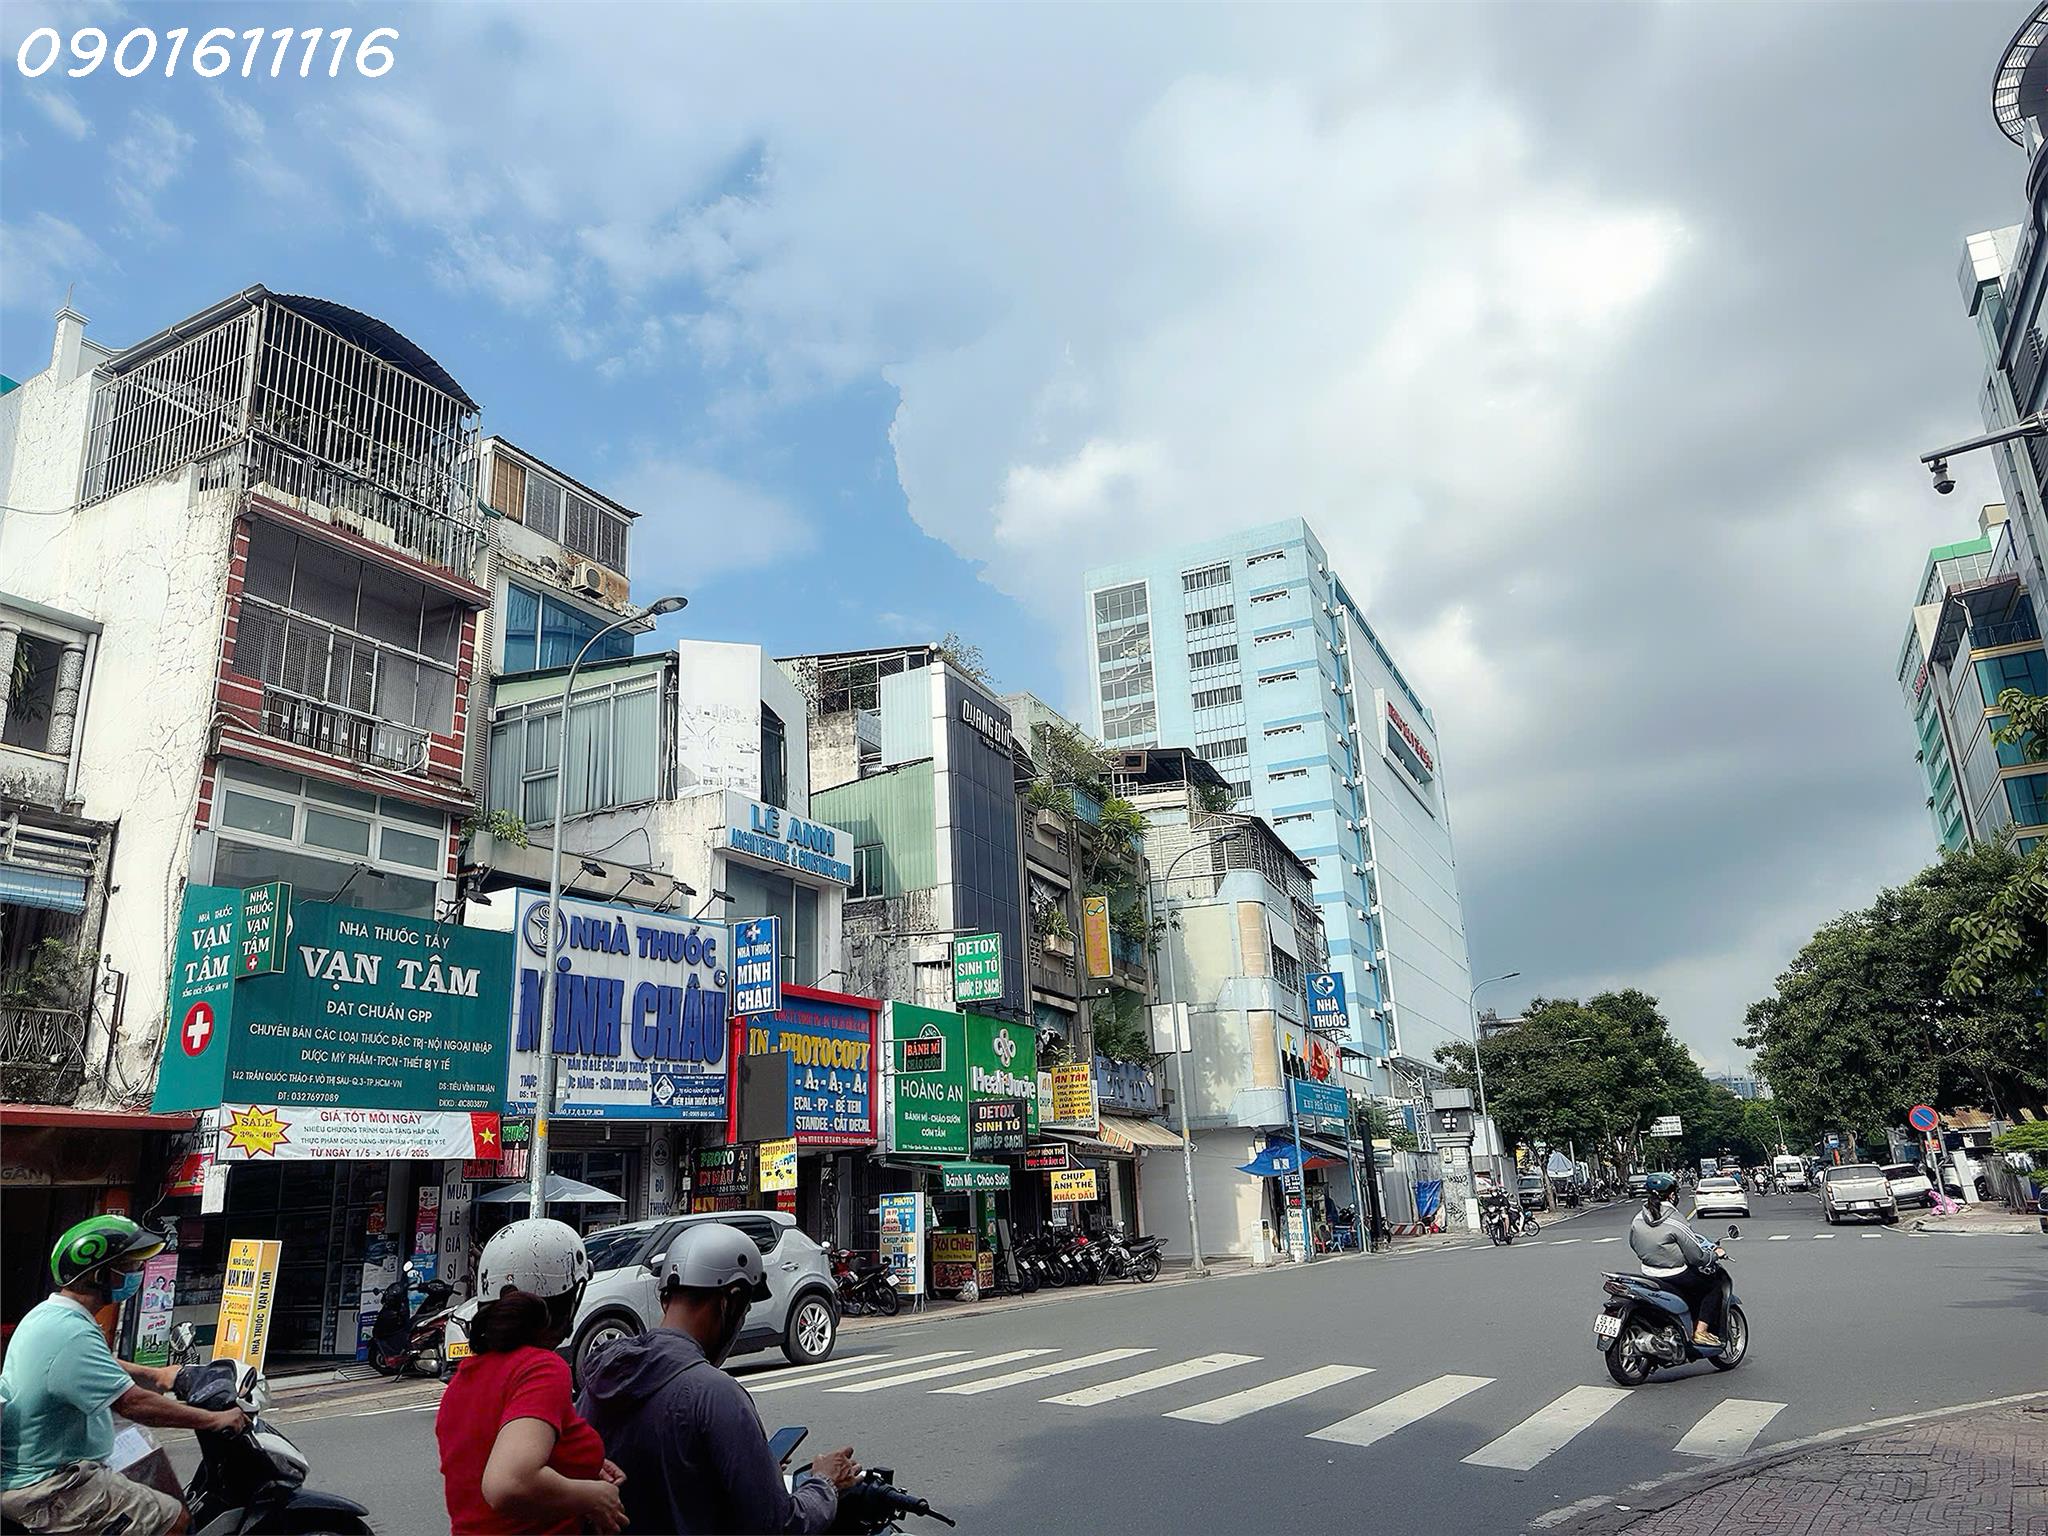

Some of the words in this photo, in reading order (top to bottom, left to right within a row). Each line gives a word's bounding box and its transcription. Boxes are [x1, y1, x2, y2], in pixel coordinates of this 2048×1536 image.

[751, 804, 780, 839] LÊ
[787, 817, 835, 857] ANH
[730, 828, 790, 865] ARCHITECTURE
[791, 847, 798, 867] &
[799, 849, 852, 883] CONSTRUCTION
[250, 887, 269, 903] NHÀ
[245, 901, 274, 917] THUỐC
[246, 916, 270, 935] VẠN
[191, 923, 233, 953] VẠN
[242, 936, 270, 956] TÂM
[374, 926, 419, 945] THUỐC
[424, 933, 450, 949] TÂY
[569, 915, 630, 956] NHÀ
[636, 926, 717, 969] THUỐC
[737, 944, 750, 959] NHÀ
[751, 941, 772, 955] THUỐC
[957, 938, 997, 957] DETOX
[184, 955, 231, 984] TÂM
[299, 946, 382, 991] VẠN
[396, 954, 481, 997] TÂM
[958, 961, 983, 976] SINH
[985, 955, 998, 974] TỐ
[737, 984, 772, 1011] CHÂU
[1316, 996, 1339, 1012] NHÀ
[327, 1000, 355, 1017] ĐẠT
[358, 1002, 404, 1021] CHUẨN
[408, 1010, 433, 1024] GPP
[631, 973, 727, 1065] CHÂU
[1312, 1011, 1348, 1028] THUỐC
[249, 1023, 290, 1037] CHUYÊN
[292, 1025, 312, 1038] BÁN
[314, 1027, 337, 1041] CÁC
[339, 1031, 359, 1045] LOẠI
[361, 1031, 390, 1045] THUỐC
[443, 1040, 471, 1053] NGOẠI
[472, 1041, 493, 1055] NHẬP
[749, 1028, 770, 1056] IN
[780, 1031, 871, 1071] PHOTOCOPY
[907, 1041, 929, 1057] BÁNH
[433, 1060, 440, 1070] Y
[441, 1058, 450, 1070] TẾ
[232, 1070, 245, 1080] 142
[803, 1069, 819, 1091] A2
[828, 1071, 843, 1094] A3
[852, 1073, 867, 1095] A4
[291, 1092, 339, 1103] 0327697089
[900, 1078, 945, 1101] HOÀNG
[947, 1085, 963, 1102] AN
[817, 1098, 829, 1111] PP
[979, 1104, 1016, 1120] DETOX
[241, 1118, 272, 1128] SALE
[320, 1110, 341, 1122] GIÁ
[344, 1110, 366, 1123] TỐT
[393, 1112, 422, 1125] NGÀY
[795, 1115, 829, 1131] STANDEE
[849, 1119, 871, 1132] DECAL
[975, 1122, 1003, 1133] SINH
[1005, 1116, 1021, 1132] TỐ
[310, 1146, 323, 1157] TỪ
[325, 1146, 351, 1157] NGÀY
[356, 1148, 371, 1158] 1/5
[411, 1149, 430, 1158] 2025
[700, 1150, 735, 1168] PHOTO
[1054, 1181, 1073, 1190] ẢNH
[1075, 1178, 1094, 1188] THẺ
[1061, 1173, 1086, 1181] CHỤP
[447, 1184, 468, 1200] MUA
[1053, 1191, 1076, 1201] KHẮC
[1078, 1189, 1095, 1199] DẤU
[894, 1197, 914, 1206] PHOTO
[449, 1206, 461, 1226] LẺ
[445, 1237, 461, 1253] GIÁ
[261, 1271, 272, 1291] TÂM
[258, 1292, 268, 1310] VẠN
